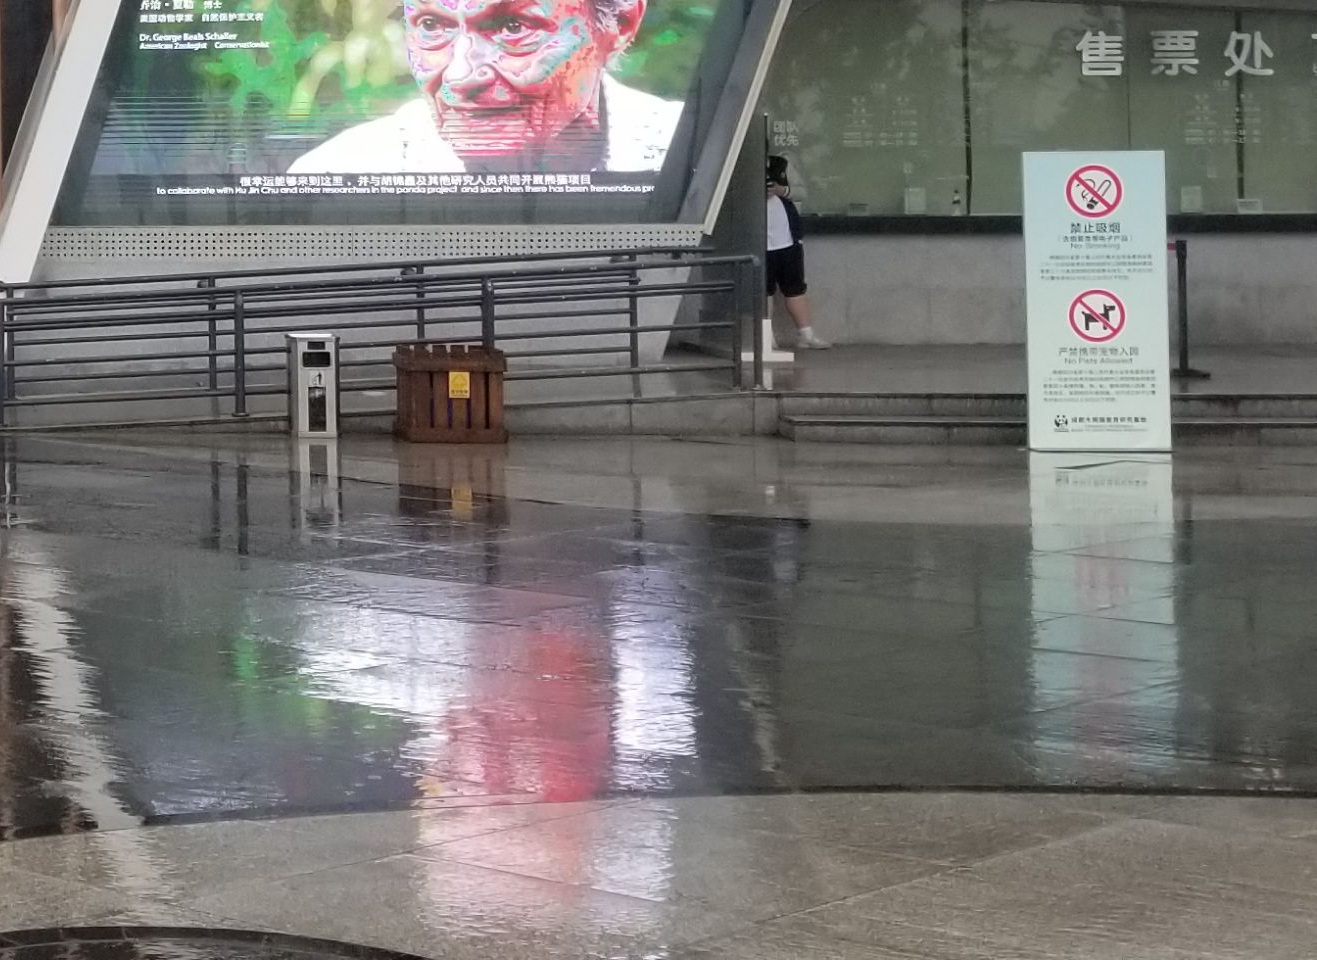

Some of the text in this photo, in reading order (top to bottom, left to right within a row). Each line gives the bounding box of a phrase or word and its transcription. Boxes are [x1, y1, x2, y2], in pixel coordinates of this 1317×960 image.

[152, 33, 182, 42] George
[1075, 30, 1274, 76] 售票处
[156, 187, 166, 195] to
[167, 186, 215, 195] collaborate
[216, 186, 234, 194] with
[280, 186, 298, 194] and
[298, 186, 321, 194] other
[396, 186, 426, 195] panda
[427, 186, 458, 195] project
[1070, 222, 1121, 234] 禁止吸烟
[1058, 346, 1140, 357] 严禁携带宠物入园
